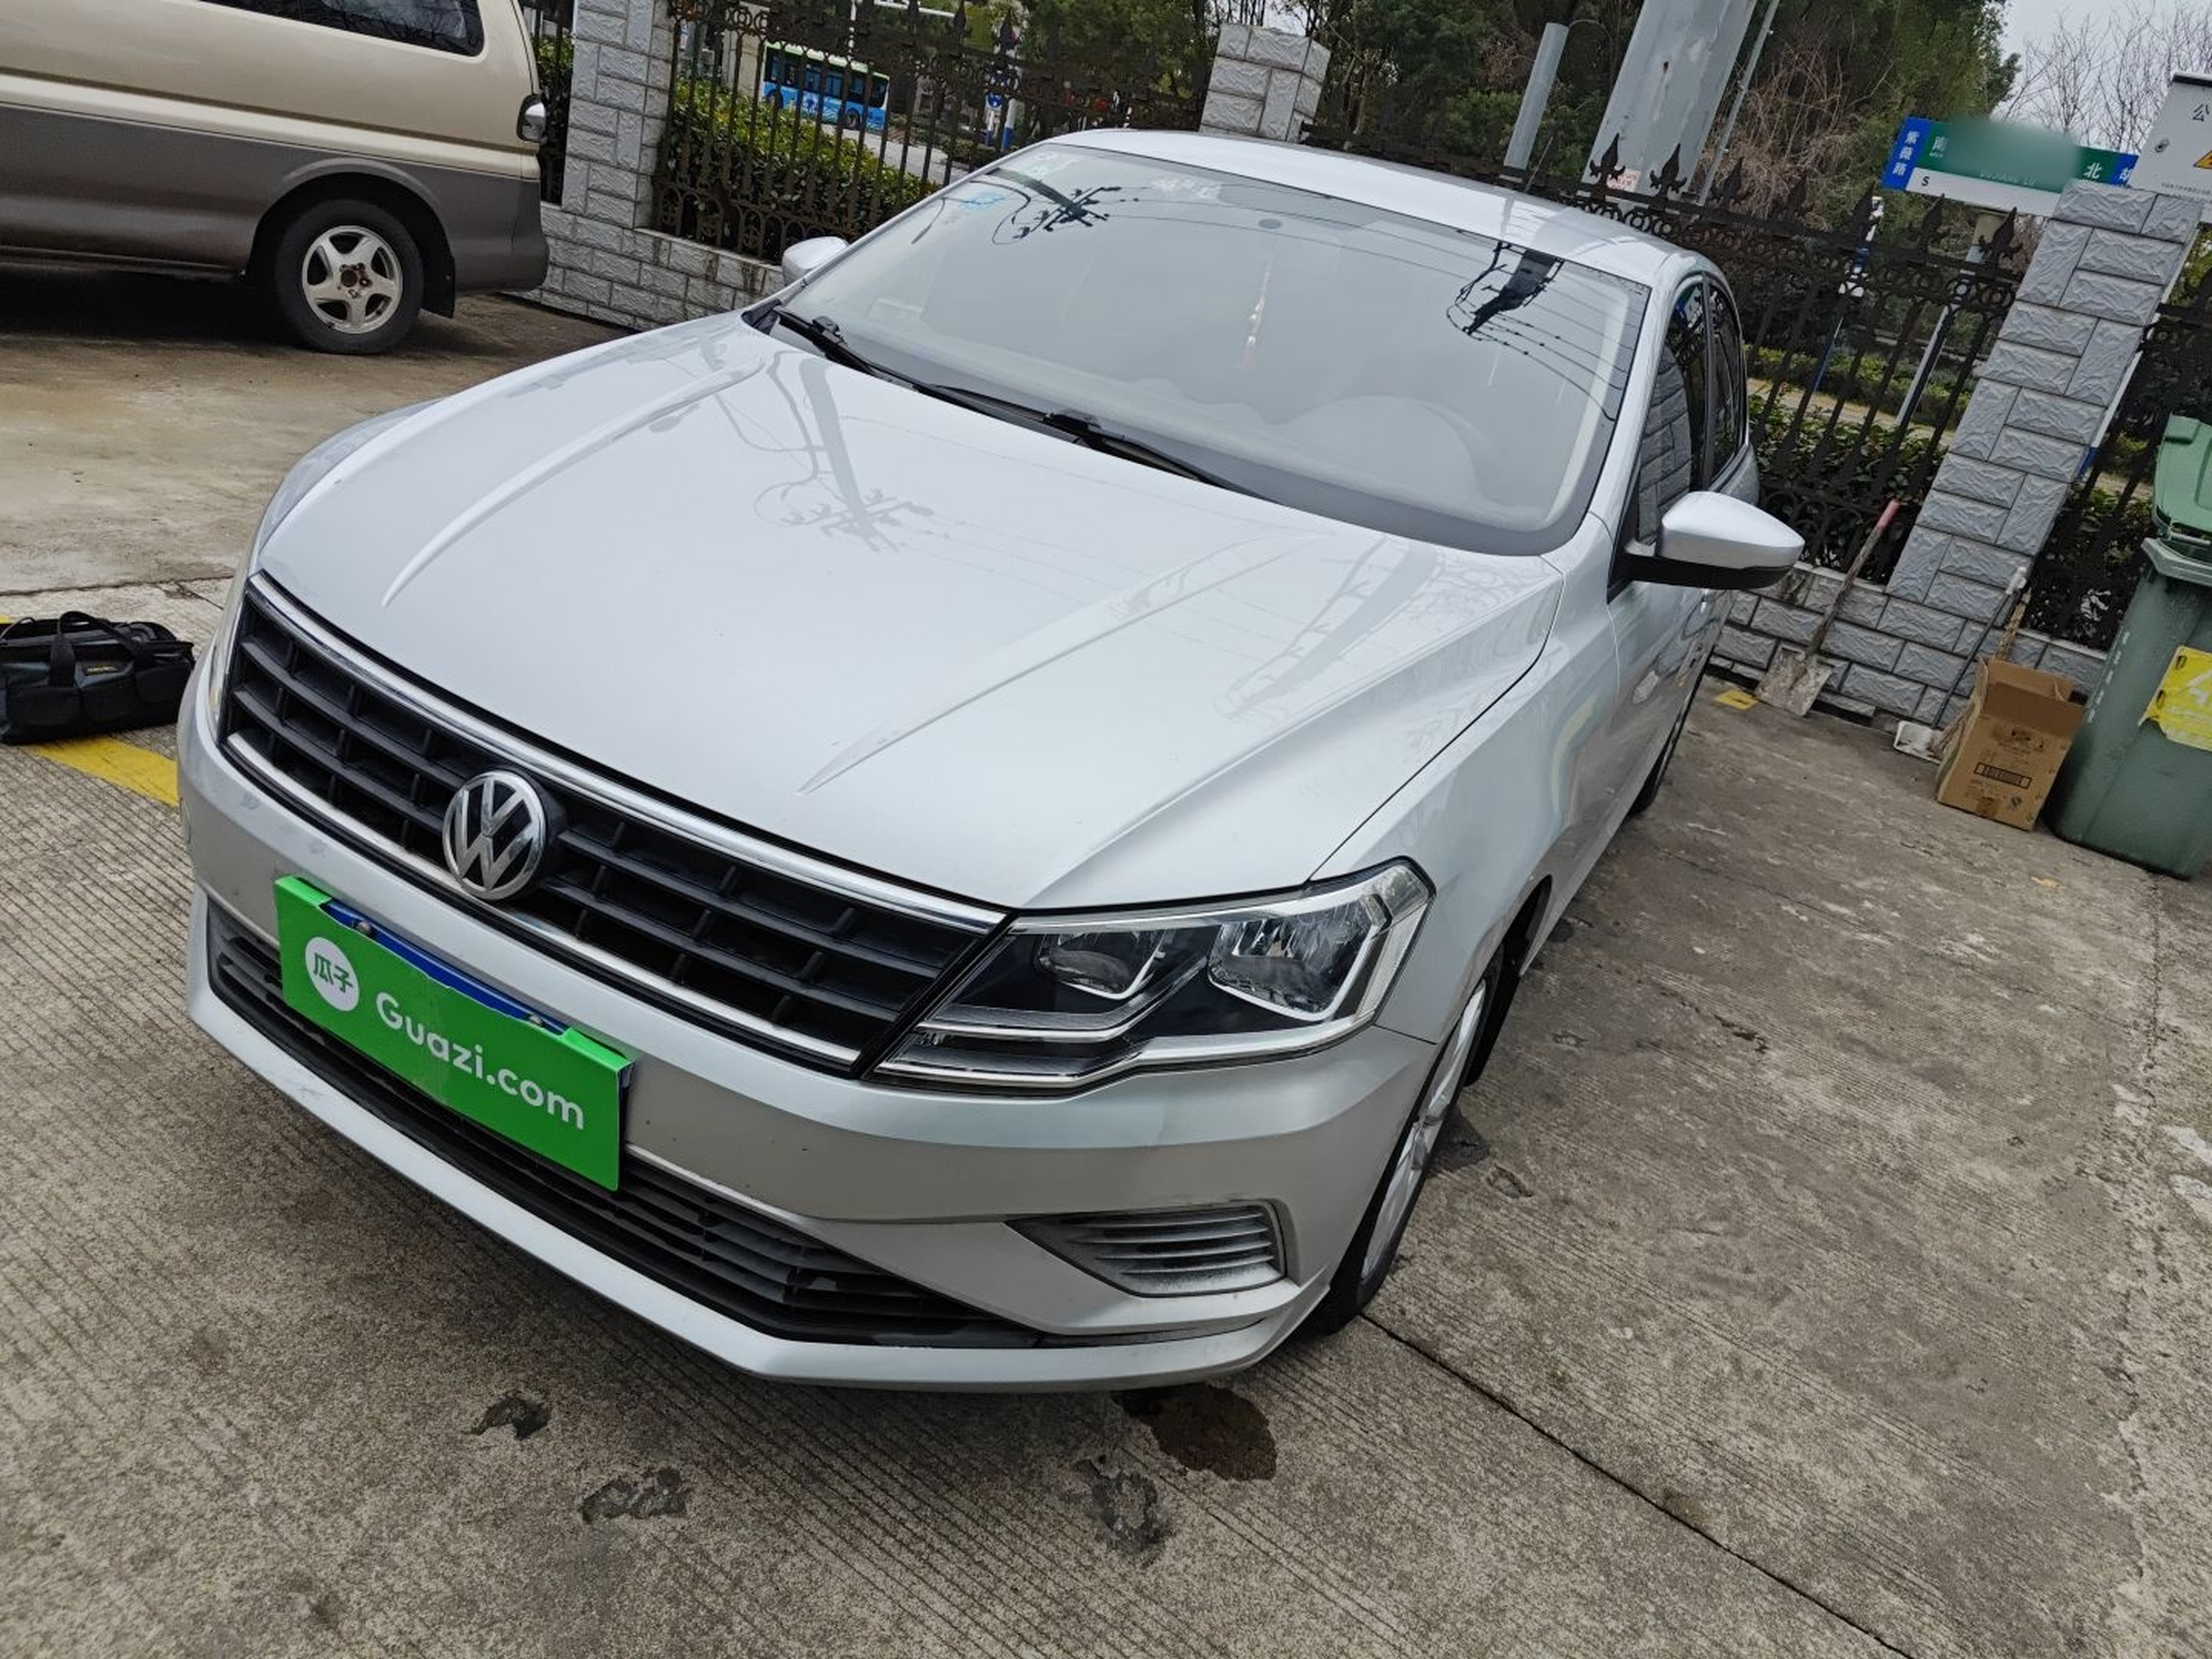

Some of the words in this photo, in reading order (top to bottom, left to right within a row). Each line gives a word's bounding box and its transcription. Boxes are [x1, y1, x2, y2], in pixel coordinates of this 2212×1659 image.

[1921, 175, 1930, 187] S
[2084, 162, 2103, 180] 北
[313, 952, 354, 993] 瓜子
[376, 992, 584, 1130] Guazi.com
